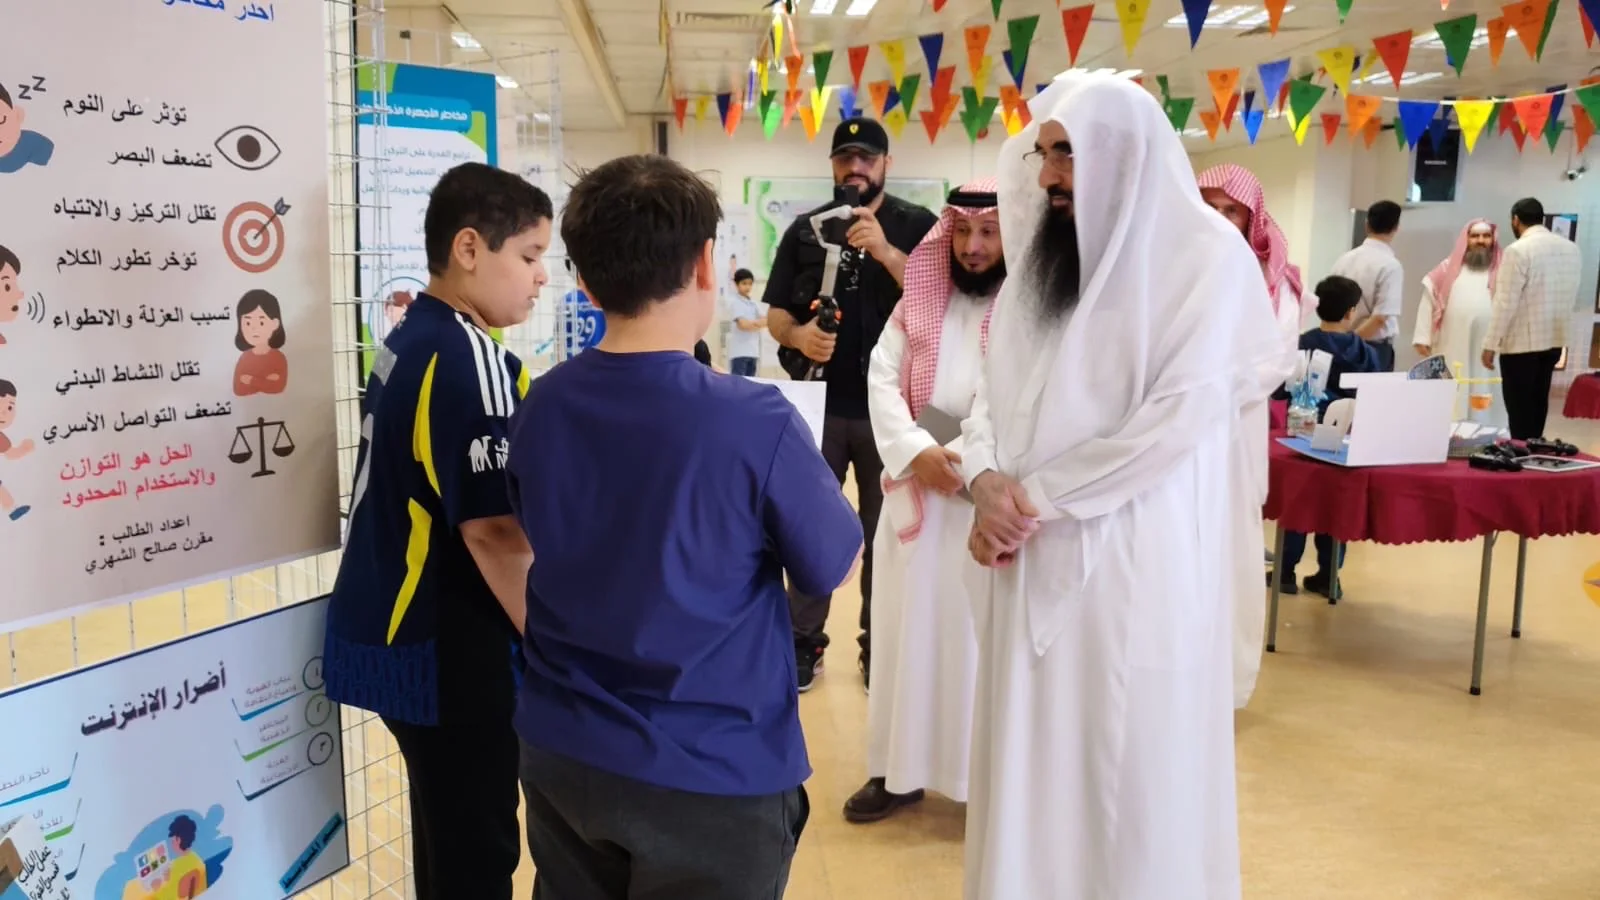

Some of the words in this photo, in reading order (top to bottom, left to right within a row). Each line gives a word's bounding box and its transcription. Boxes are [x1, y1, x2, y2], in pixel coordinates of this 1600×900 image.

[64, 94, 103, 115] النوم
[112, 99, 143, 122] على
[153, 103, 186, 126] تؤثر
[110, 147, 154, 166] البصر
[162, 153, 212, 168] تضعف
[54, 198, 120, 221] والانتباه
[128, 203, 180, 223] التركيز
[188, 205, 216, 224] تقلل
[57, 249, 101, 272] الكلام
[111, 249, 151, 271] تطور
[159, 252, 197, 271] تؤخر
[53, 308, 133, 330] والانطواء
[139, 304, 183, 327] العزلة
[190, 307, 230, 325] تسبب
[56, 367, 105, 395] البدني
[112, 363, 163, 382] النشاط
[171, 361, 200, 381] تقلل
[114, 407, 176, 432] التواصل
[185, 402, 231, 420] تضعف
[43, 412, 105, 444] الأسري
[131, 453, 151, 470] هو
[160, 443, 192, 463] الحل
[60, 453, 120, 480] التوازن
[63, 480, 127, 507] المحدود
[136, 469, 215, 498] والاستخدام
[113, 522, 153, 543] الطالب
[183, 532, 213, 551] مقرن
[86, 548, 136, 574] الشهري
[143, 542, 176, 562] صالح
[173, 661, 226, 710] أضرار
[81, 687, 166, 736] الإنترنت
